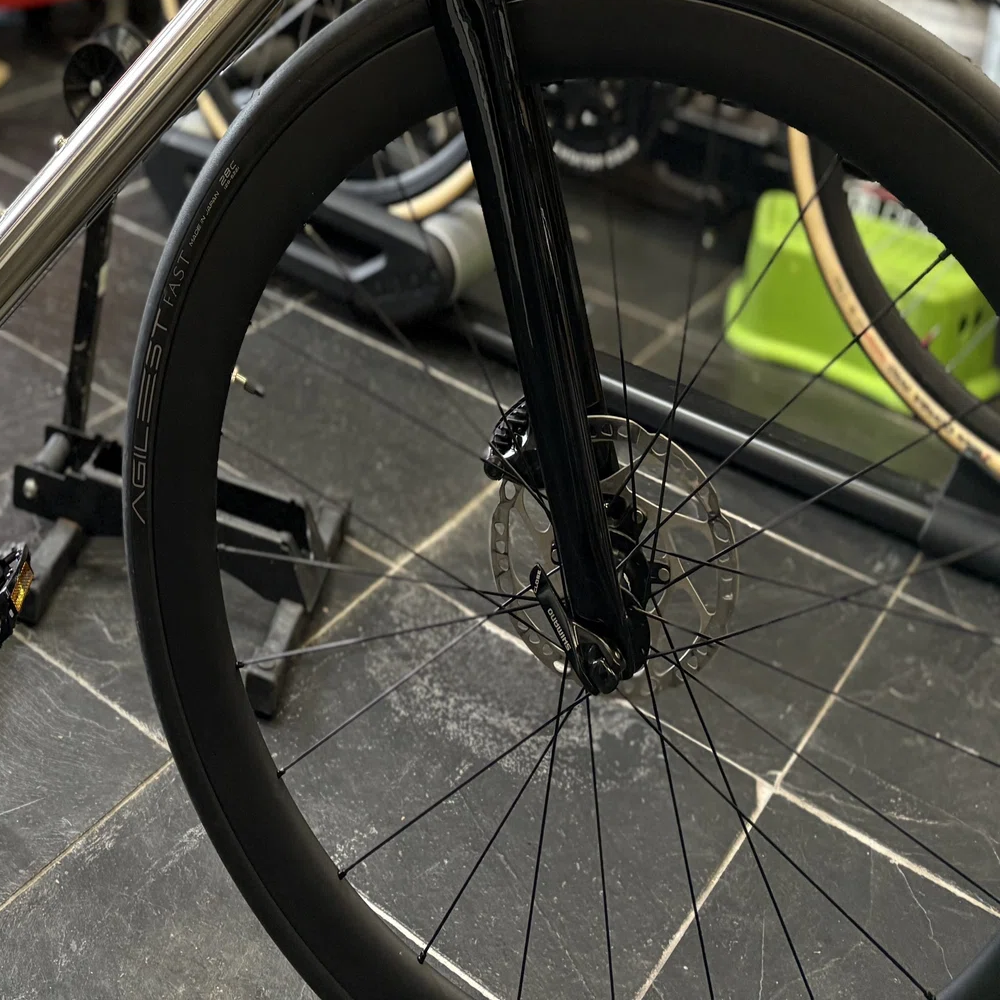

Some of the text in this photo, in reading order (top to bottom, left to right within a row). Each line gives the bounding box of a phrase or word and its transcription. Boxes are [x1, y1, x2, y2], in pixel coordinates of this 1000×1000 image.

[218, 160, 237, 187] 28C
[131, 307, 169, 525] AGILEST
[163, 250, 191, 308] FAST
[205, 190, 220, 215] JAPAN
[547, 607, 572, 652] SHIMANO
